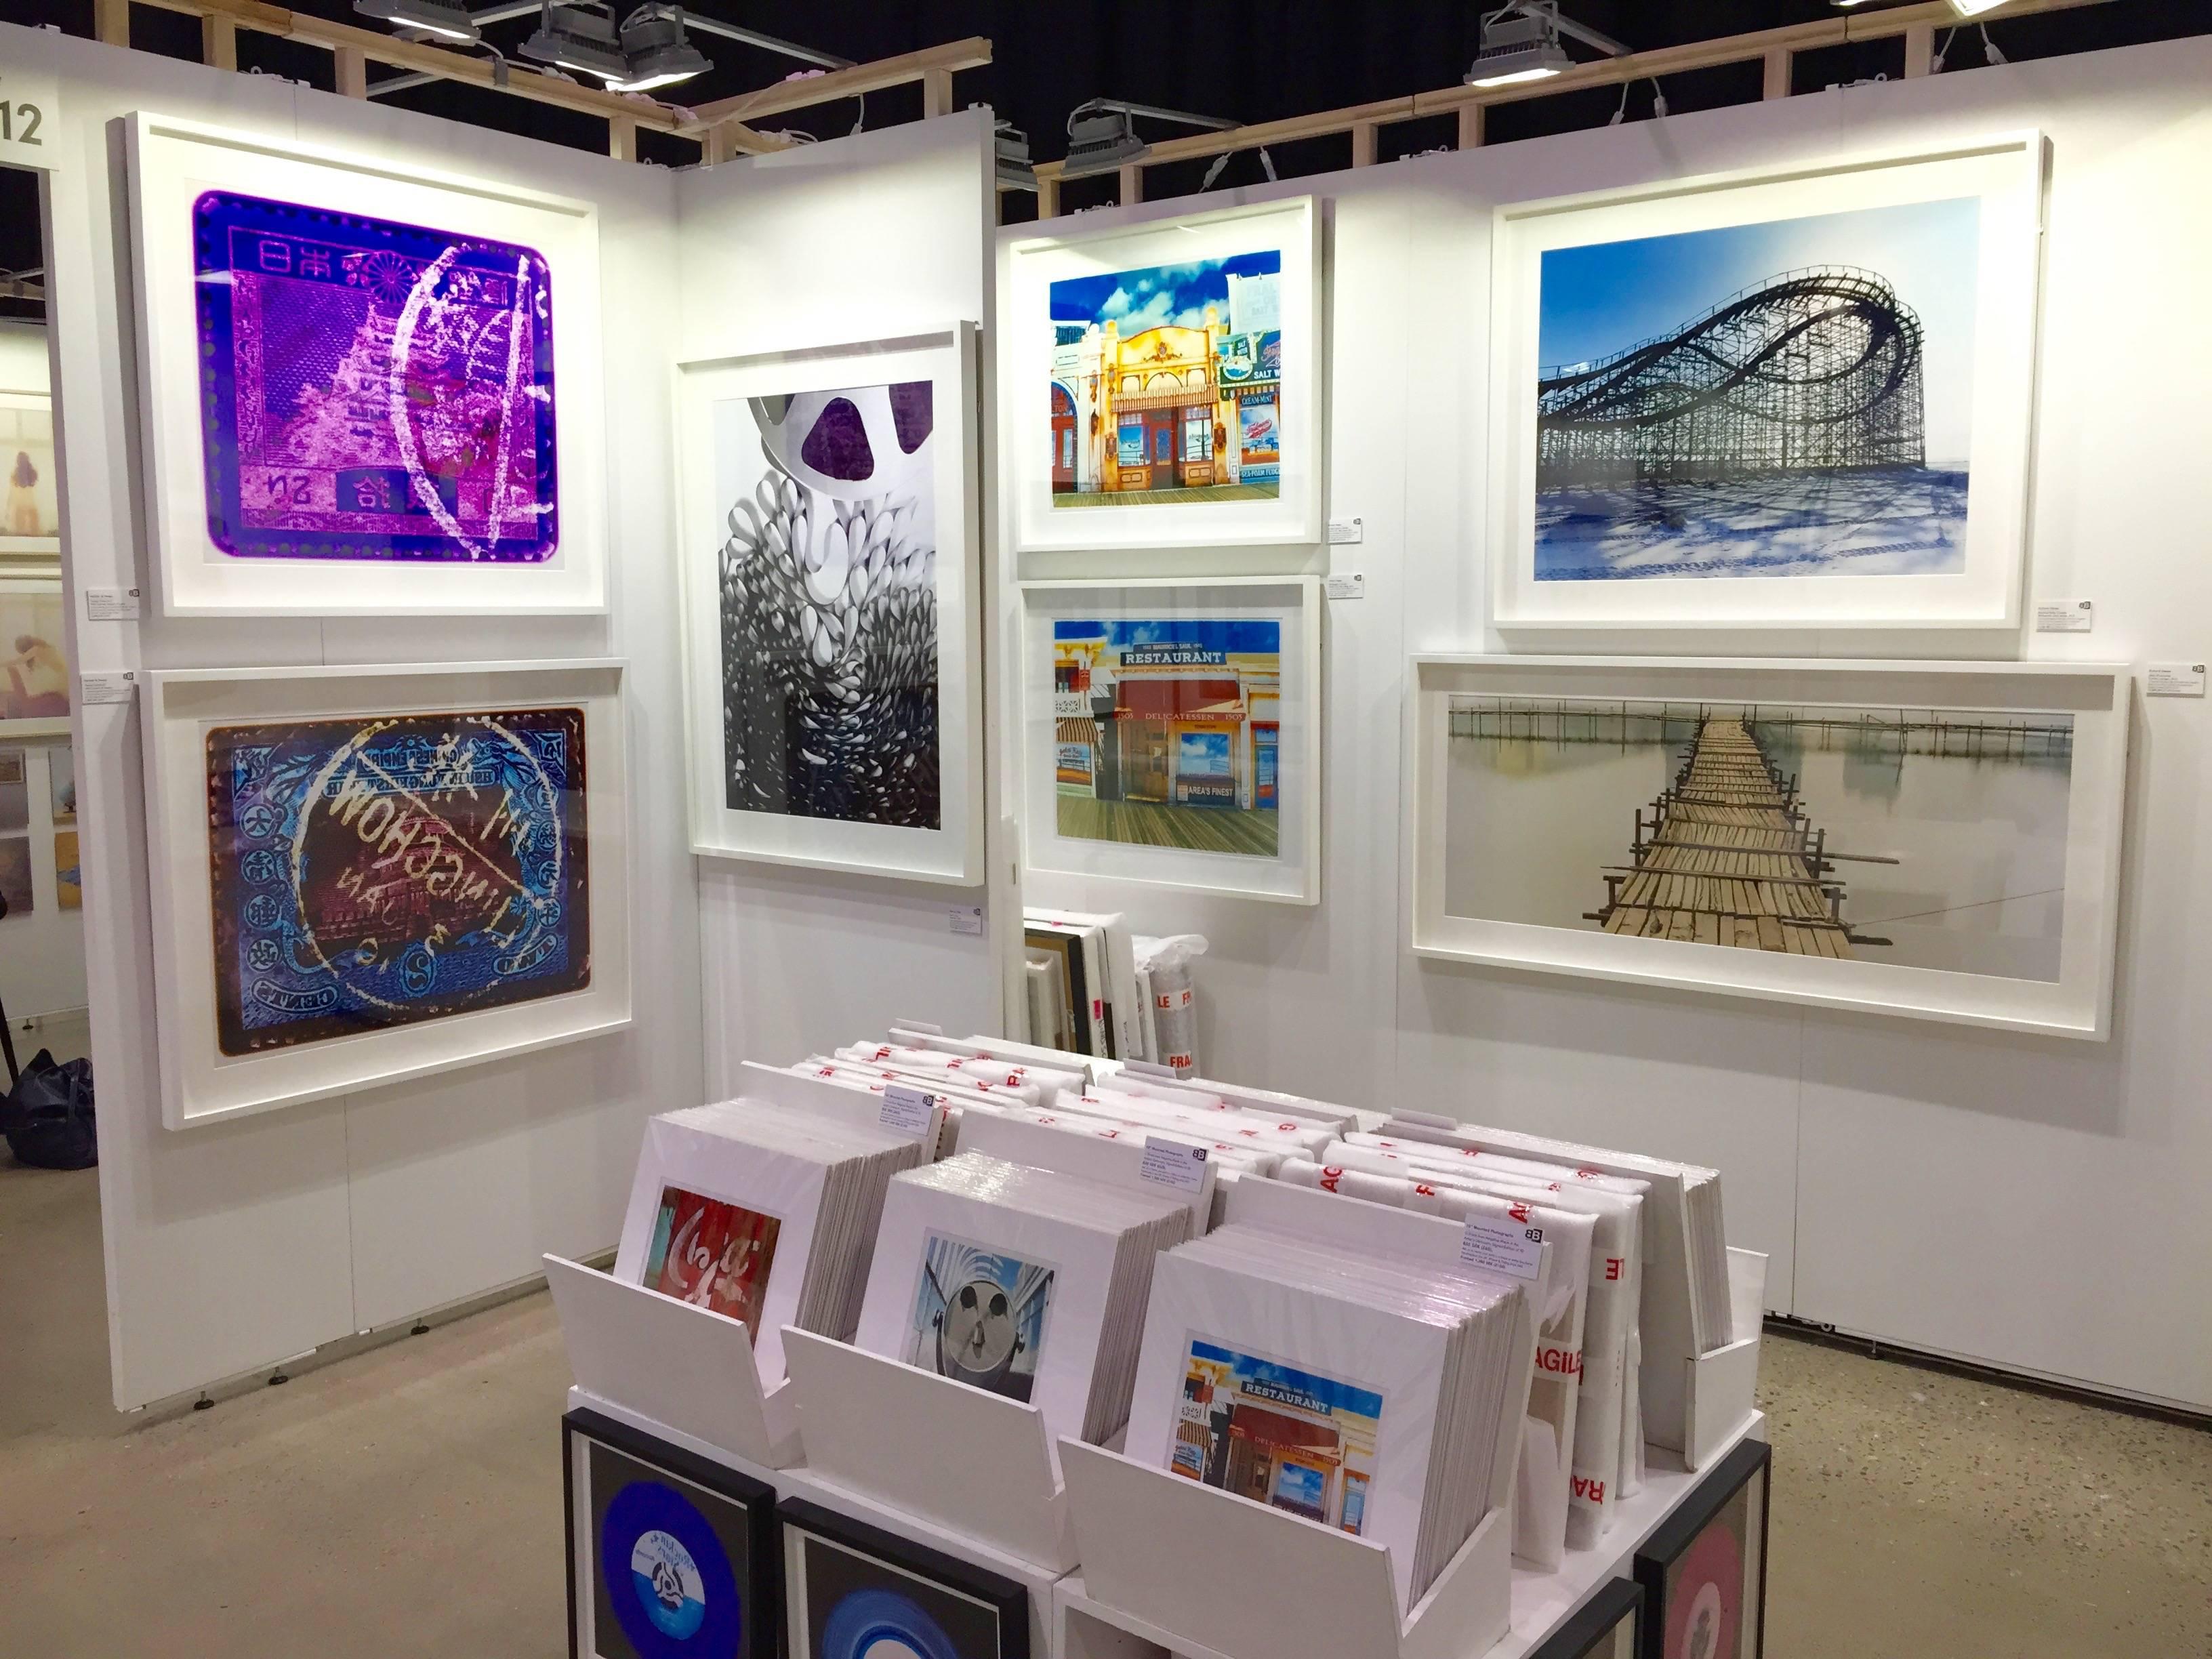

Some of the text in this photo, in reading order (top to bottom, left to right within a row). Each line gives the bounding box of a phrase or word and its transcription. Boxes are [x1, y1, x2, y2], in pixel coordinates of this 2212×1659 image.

[1254, 371, 1272, 380] SALT
[1125, 652, 1221, 664] RESTAURANT
[1145, 713, 1214, 721] DELICATESSEN
[1188, 786, 1233, 797] AREA'S FINEST
[1246, 1383, 1328, 1414] RESTAURANT
[1255, 1436, 1313, 1460] DELICATESSEN
